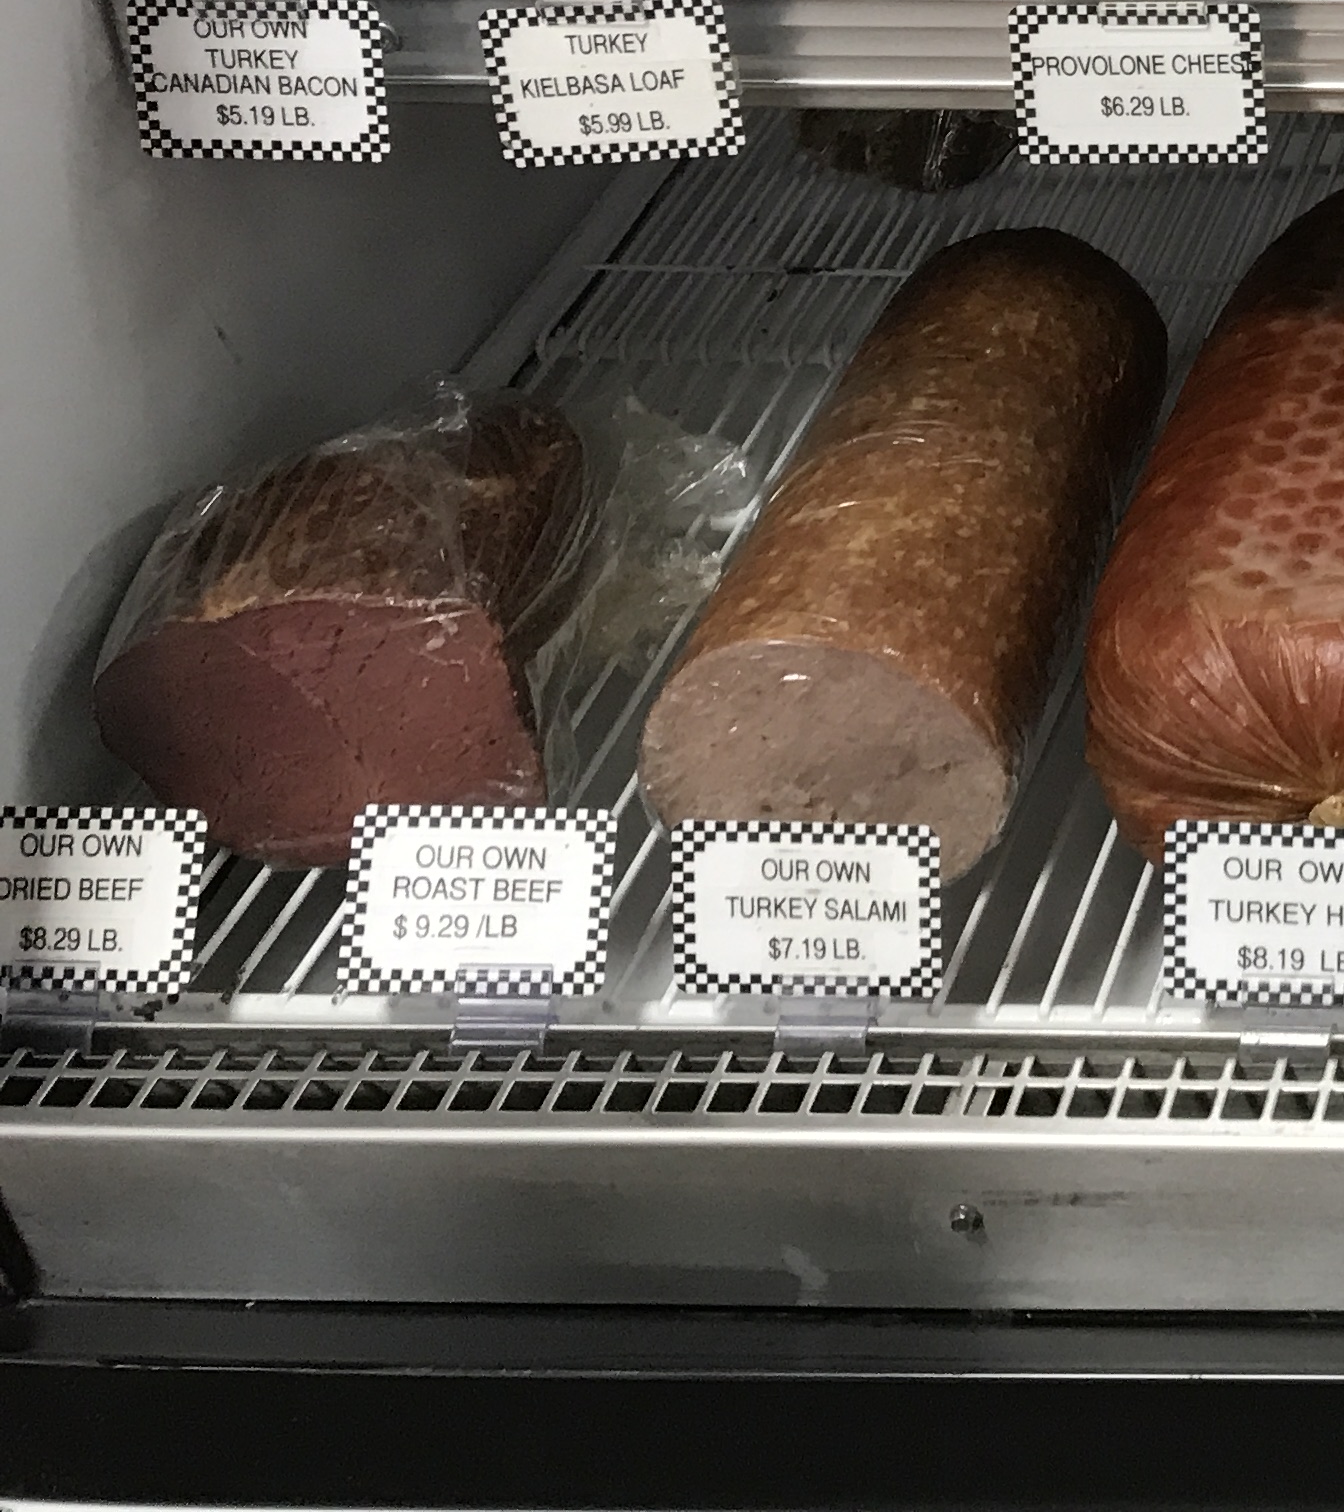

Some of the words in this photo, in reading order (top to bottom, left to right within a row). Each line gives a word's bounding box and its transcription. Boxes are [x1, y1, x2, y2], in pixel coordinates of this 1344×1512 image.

[193, 18, 244, 39] OUR
[251, 19, 308, 39] OWN
[564, 33, 648, 55] TURKEY
[204, 49, 299, 70] TURKEY
[1032, 55, 1166, 77] PROVOLONE
[150, 72, 271, 95] CANADIAN
[278, 76, 358, 97] BACON
[520, 73, 625, 99] KIELBASA
[629, 69, 685, 92] LOAF
[217, 104, 275, 126] $5.19
[281, 106, 316, 127] LB.
[1101, 96, 1154, 118] $6.29
[1160, 97, 1190, 117] LB.
[579, 113, 632, 136] $5.99
[637, 111, 671, 132] LB.
[20, 832, 74, 857] OUR
[82, 833, 143, 857] OWN
[415, 844, 474, 869] OUR
[482, 845, 547, 870] OWN
[761, 858, 809, 881] OUR
[816, 861, 871, 884] OWN
[1223, 857, 1283, 881] OUR
[0, 877, 71, 901] DRIED
[79, 878, 144, 901] BEEF
[392, 876, 485, 901] ROAST
[493, 879, 563, 903] BEEF
[725, 896, 818, 919] TURKEY
[825, 898, 908, 923] SALAMI
[1208, 898, 1317, 925] TURKEY
[19, 924, 81, 951] $8.29
[87, 928, 123, 952] LB.
[769, 936, 827, 961] $7.19
[833, 938, 867, 960] LB.
[1238, 945, 1305, 971] $8.19
